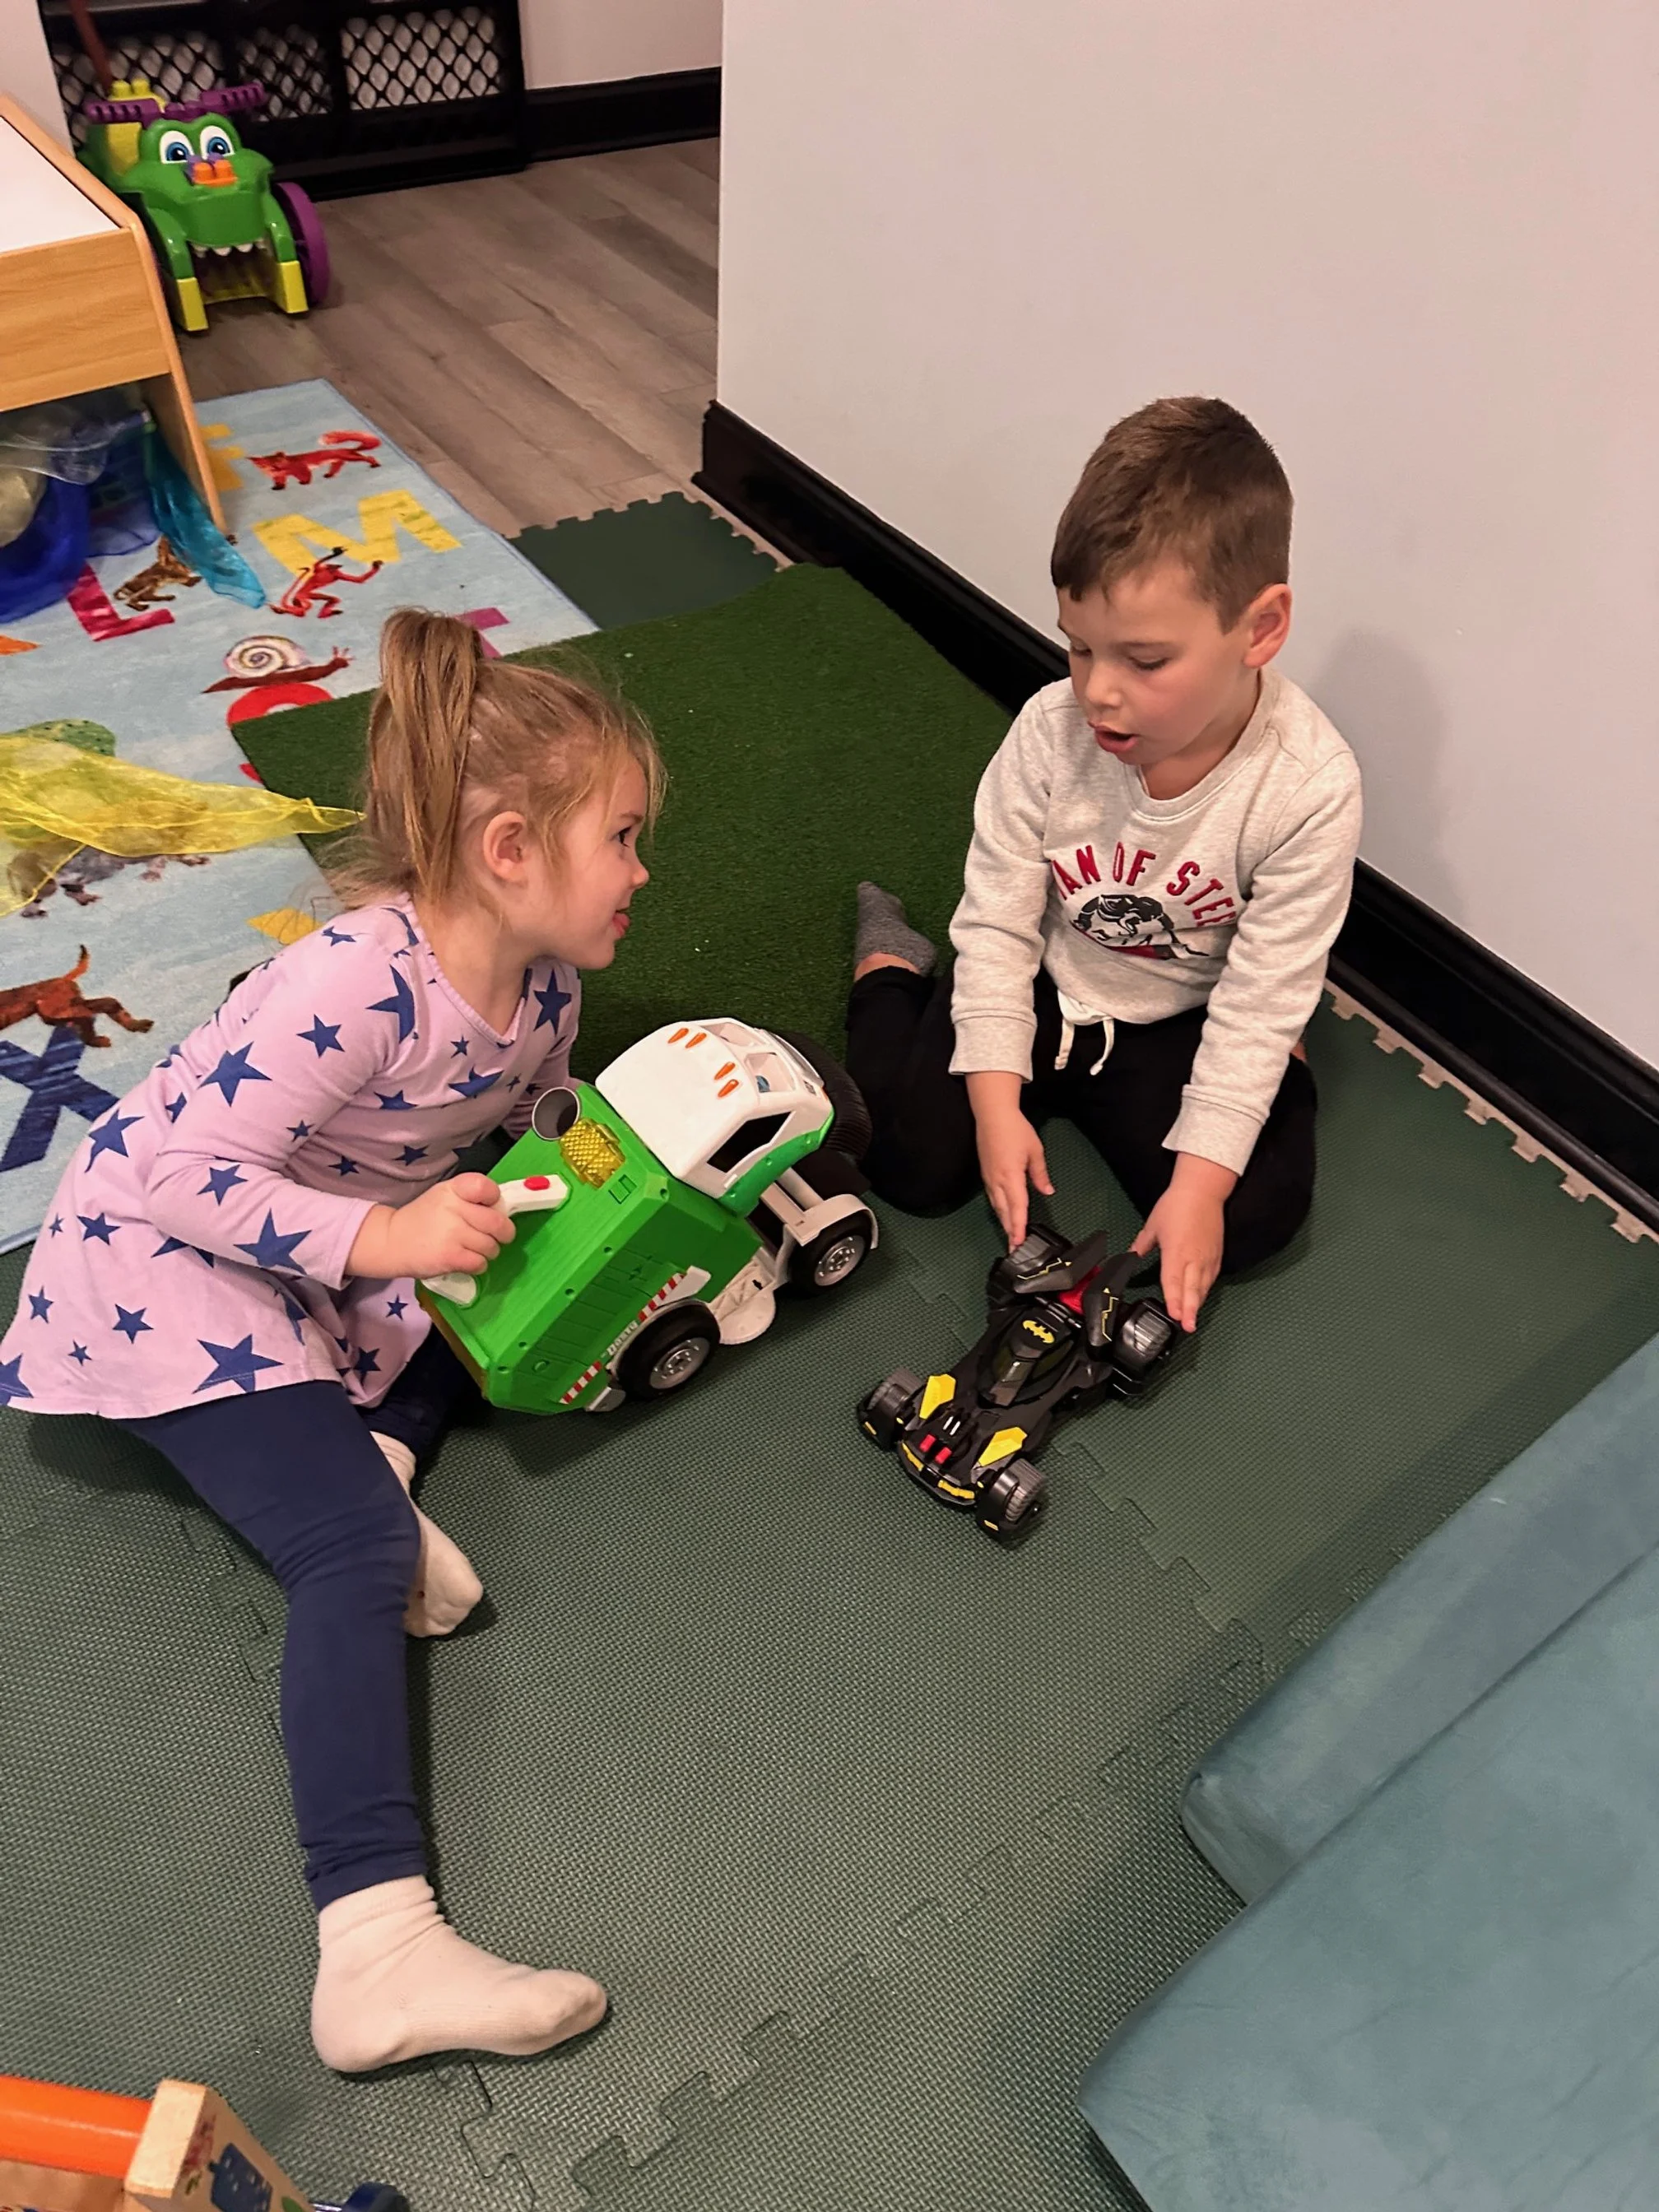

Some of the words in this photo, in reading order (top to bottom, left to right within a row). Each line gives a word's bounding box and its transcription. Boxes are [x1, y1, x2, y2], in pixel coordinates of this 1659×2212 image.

[251, 489, 462, 580] M
[67, 560, 175, 642] L
[1052, 844, 1101, 900] AN
[1113, 842, 1156, 886] OF
[1166, 861, 1236, 927] STEE
[0, 1022, 121, 1172] X
